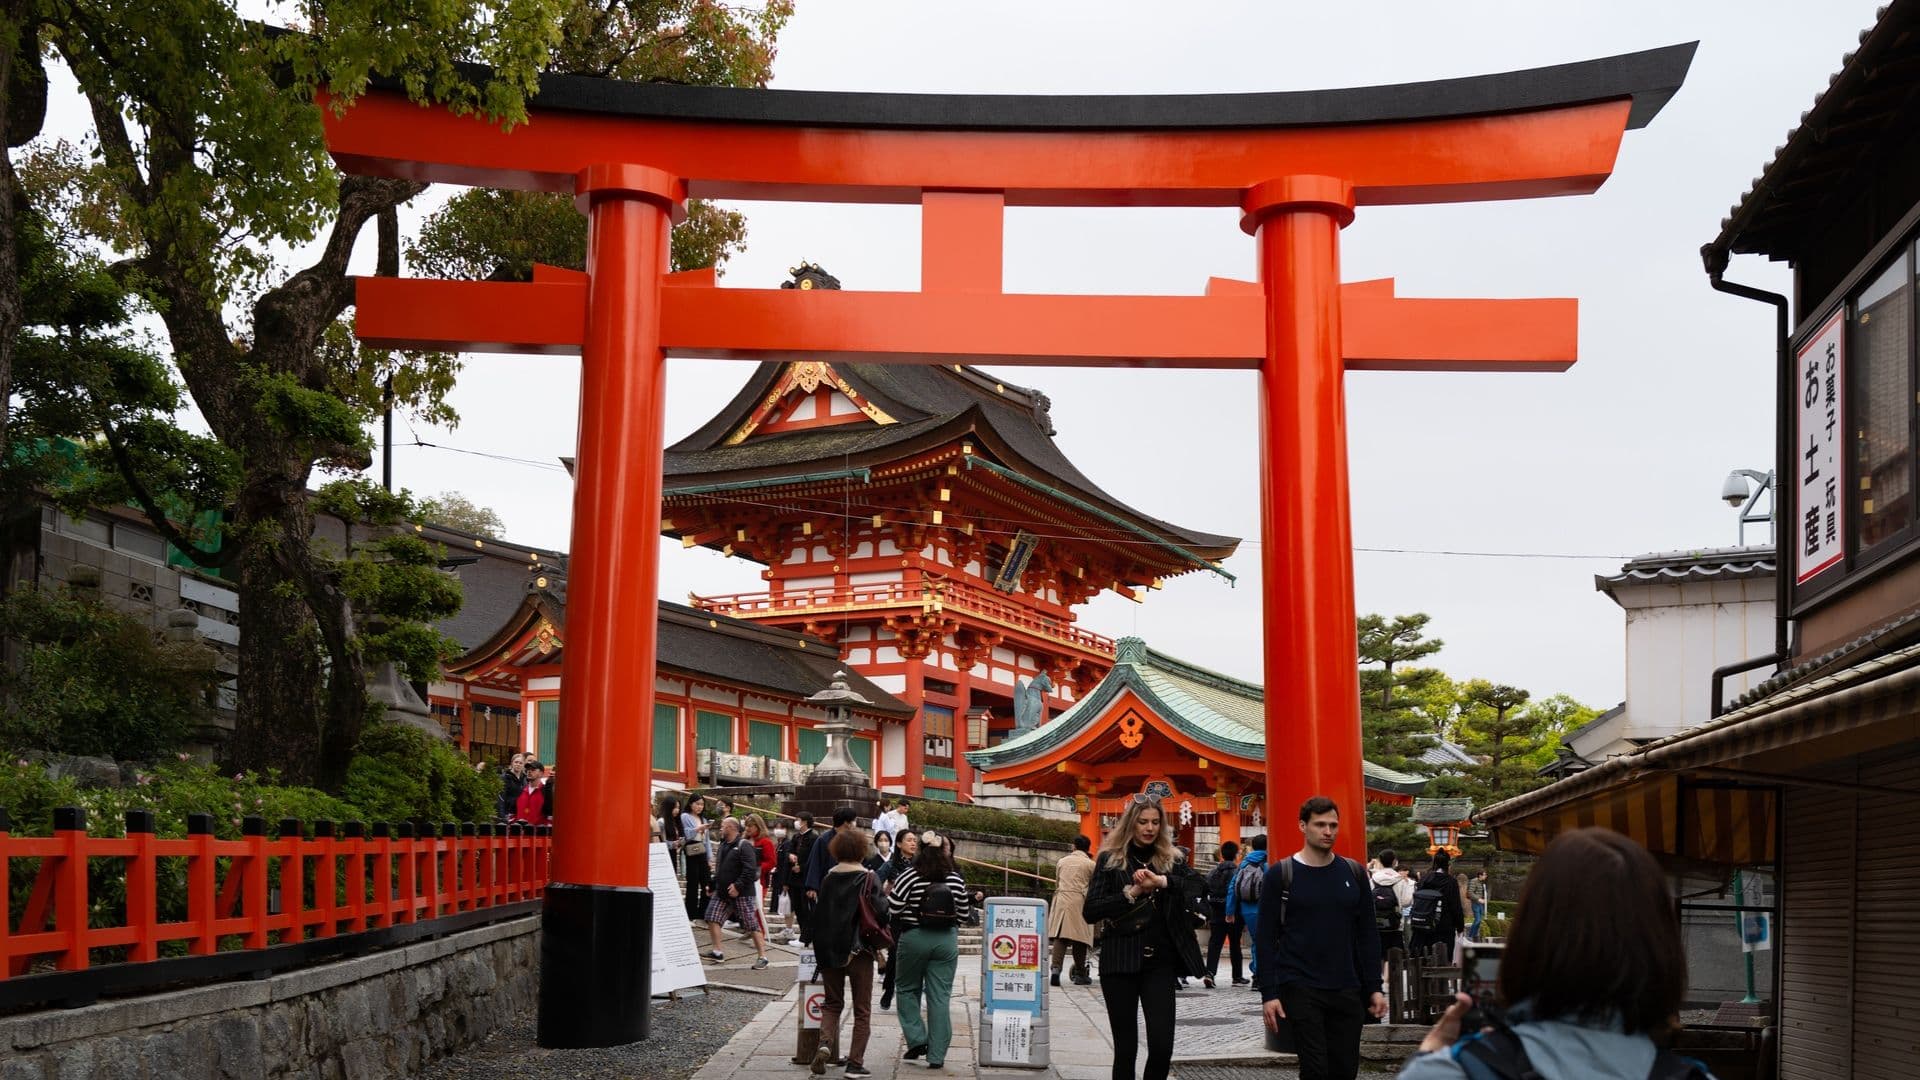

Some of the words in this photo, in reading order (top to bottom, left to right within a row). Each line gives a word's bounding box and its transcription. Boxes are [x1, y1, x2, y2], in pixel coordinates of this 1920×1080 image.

[1804, 360, 1820, 557] お土産
[1825, 342, 1836, 546] お菓子・玩具
[995, 918, 1034, 928] 飲食禁止
[994, 982, 1033, 992] 二輪下車
